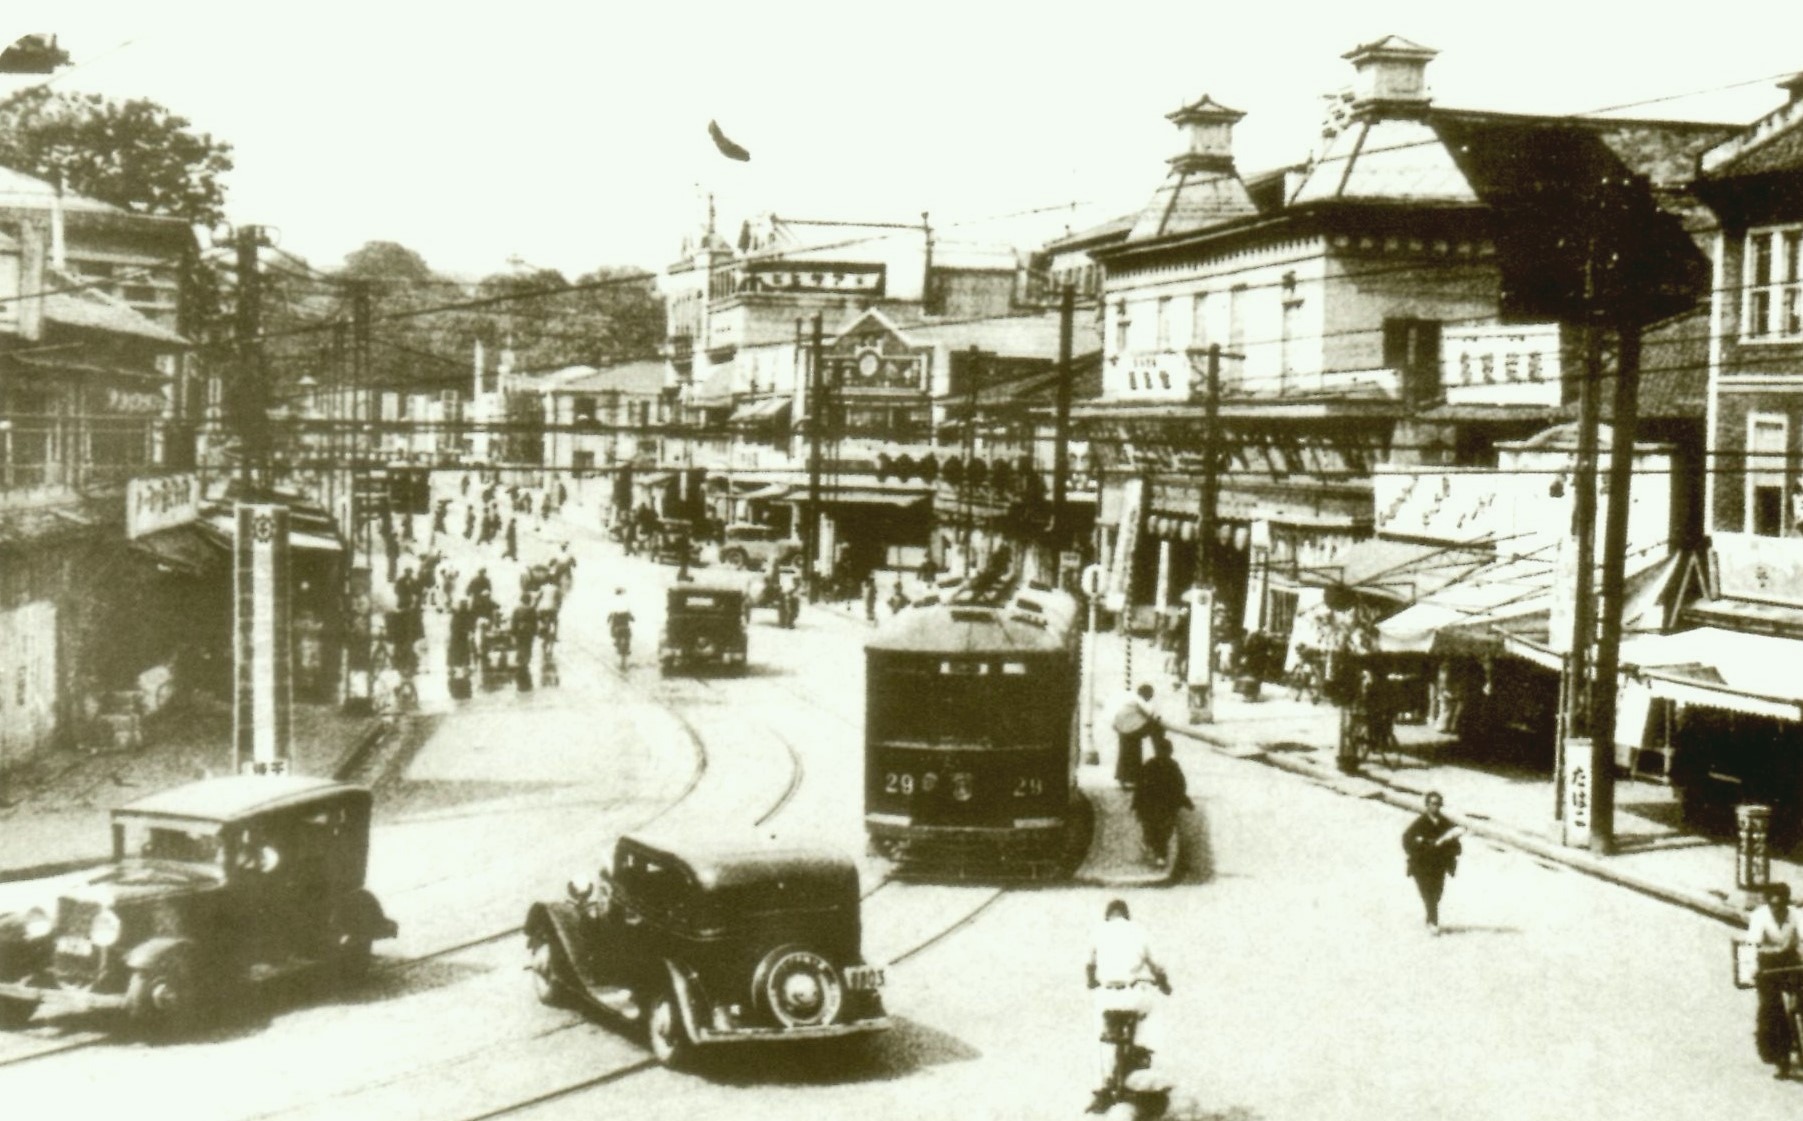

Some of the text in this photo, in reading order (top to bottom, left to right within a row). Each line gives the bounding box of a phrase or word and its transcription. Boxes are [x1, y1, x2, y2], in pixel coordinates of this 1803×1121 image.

[885, 772, 914, 795] 29
[1572, 766, 1587, 827] たばこ
